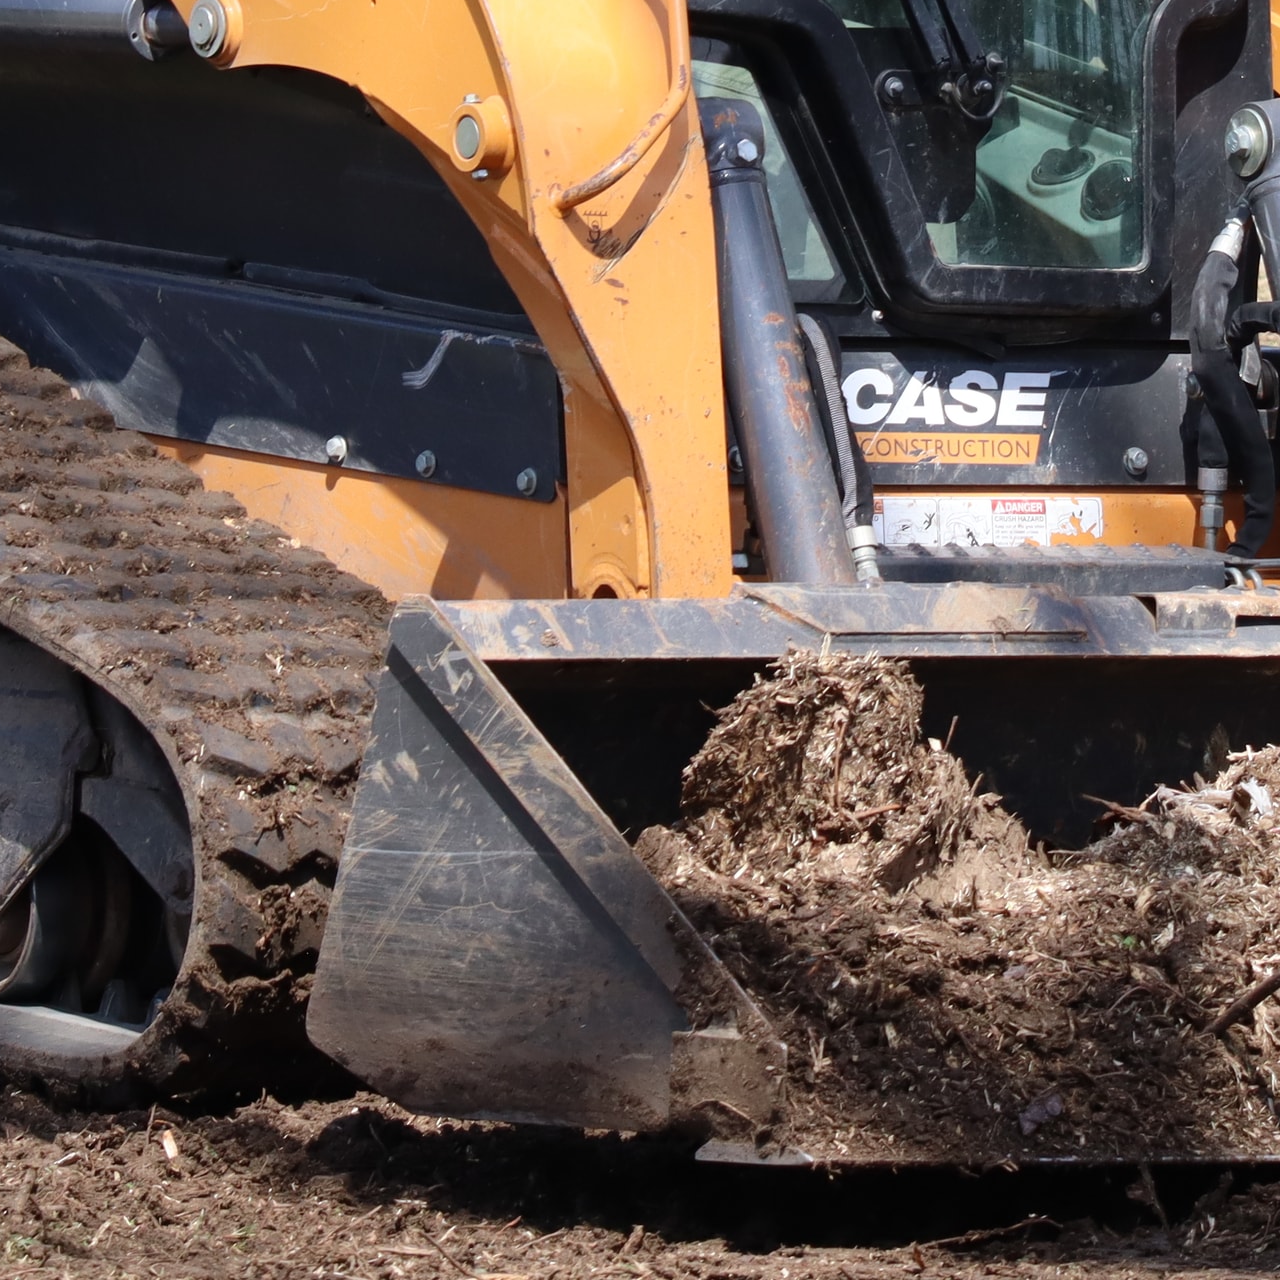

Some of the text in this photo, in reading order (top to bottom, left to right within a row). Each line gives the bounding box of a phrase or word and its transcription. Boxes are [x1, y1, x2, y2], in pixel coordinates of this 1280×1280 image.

[841, 367, 1052, 427] CASE
[860, 437, 1031, 459] CONSTRUCTION
[1004, 502, 1043, 513] DANGER
